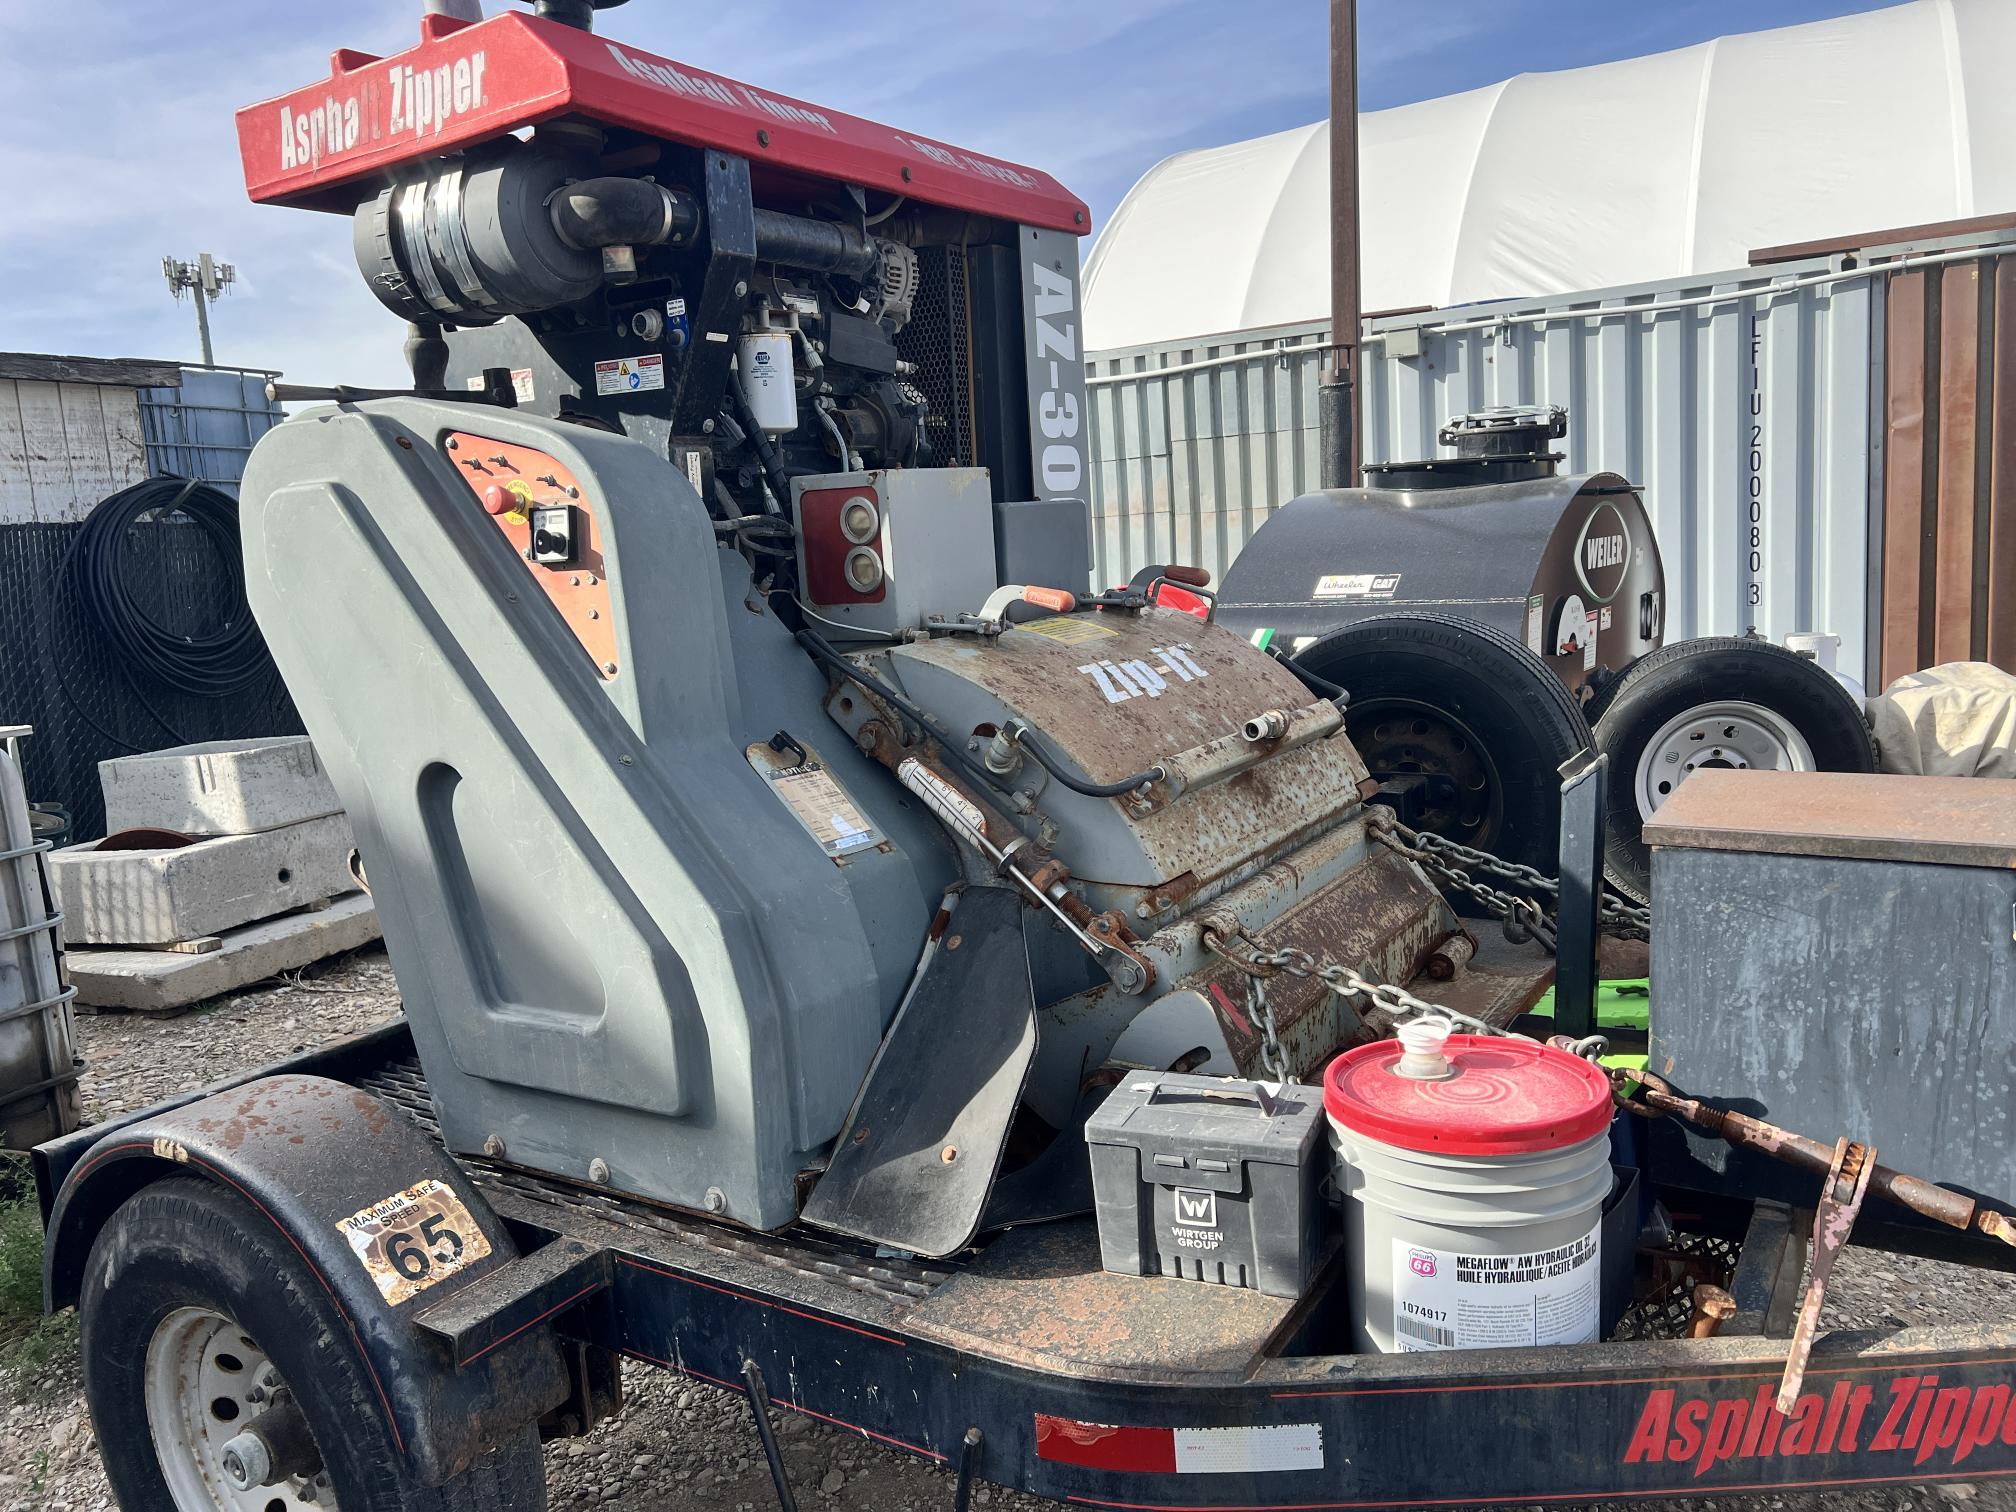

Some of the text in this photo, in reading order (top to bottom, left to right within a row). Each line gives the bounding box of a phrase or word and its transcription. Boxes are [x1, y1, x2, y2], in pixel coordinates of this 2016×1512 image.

[606, 43, 744, 108] Asphalt
[1033, 262, 1081, 492] AZ-30
[1749, 316, 1761, 605] LFIU 200080 3
[1587, 535, 1623, 570] WEILER
[1323, 579, 1365, 590] Wheeler
[347, 1181, 438, 1230] MAXIMUM SAFE
[380, 1203, 421, 1228] SPEED
[385, 1212, 464, 1282] 65
[1171, 1226, 1224, 1242] WIRTGEN
[1177, 1238, 1219, 1251] GROUP
[1412, 1260, 1432, 1273] 66
[1517, 1255, 1534, 1269] AW
[1535, 1246, 1575, 1267] HYDRAULIC
[1575, 1239, 1584, 1255] OIL
[1456, 1269, 1483, 1284] HUILE
[1402, 1301, 1447, 1322] 1074917
[1624, 1380, 1873, 1479] Asphalt
